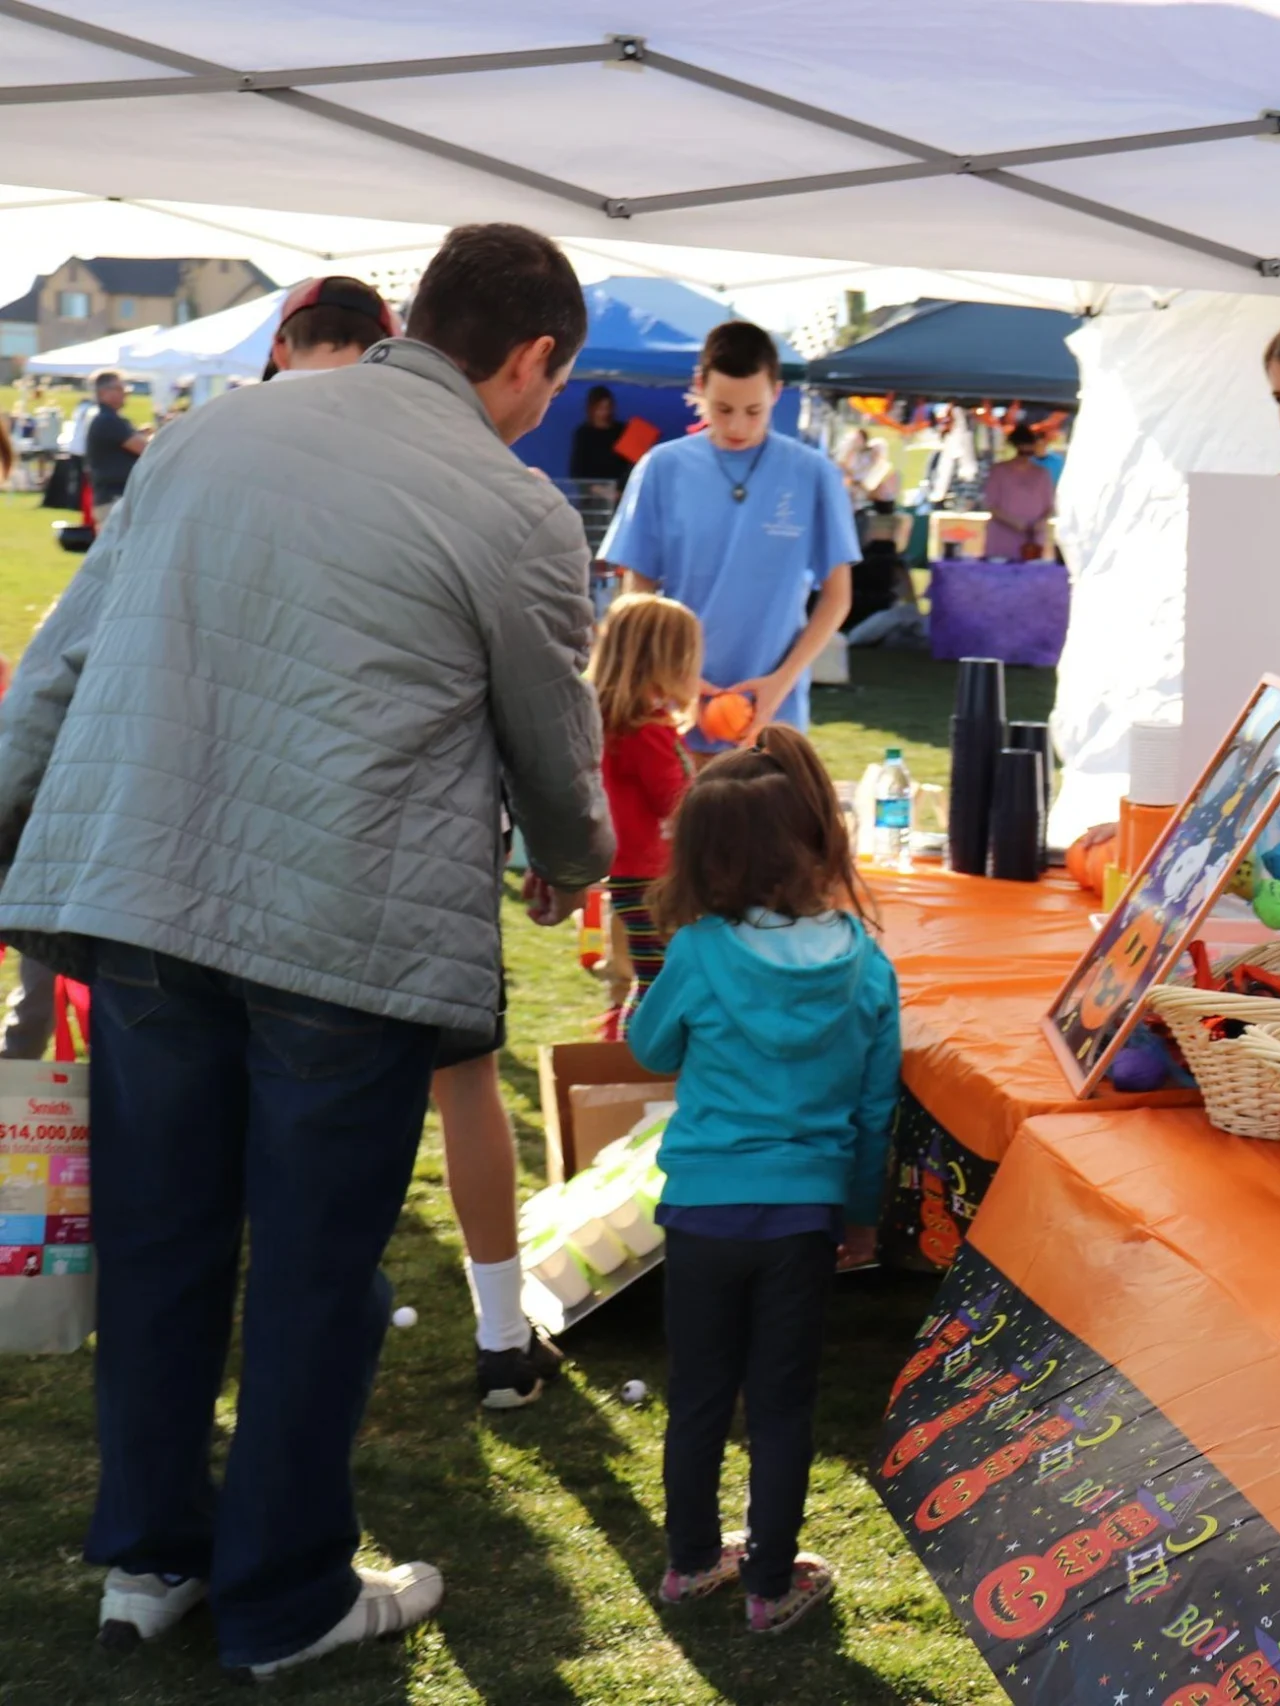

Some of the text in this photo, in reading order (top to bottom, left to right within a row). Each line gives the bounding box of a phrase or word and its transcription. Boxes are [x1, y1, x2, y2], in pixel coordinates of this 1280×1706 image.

[1060, 1478, 1124, 1515] BOO!
[1124, 1541, 1173, 1605] EEK!
[1160, 1603, 1240, 1663] BOO!
